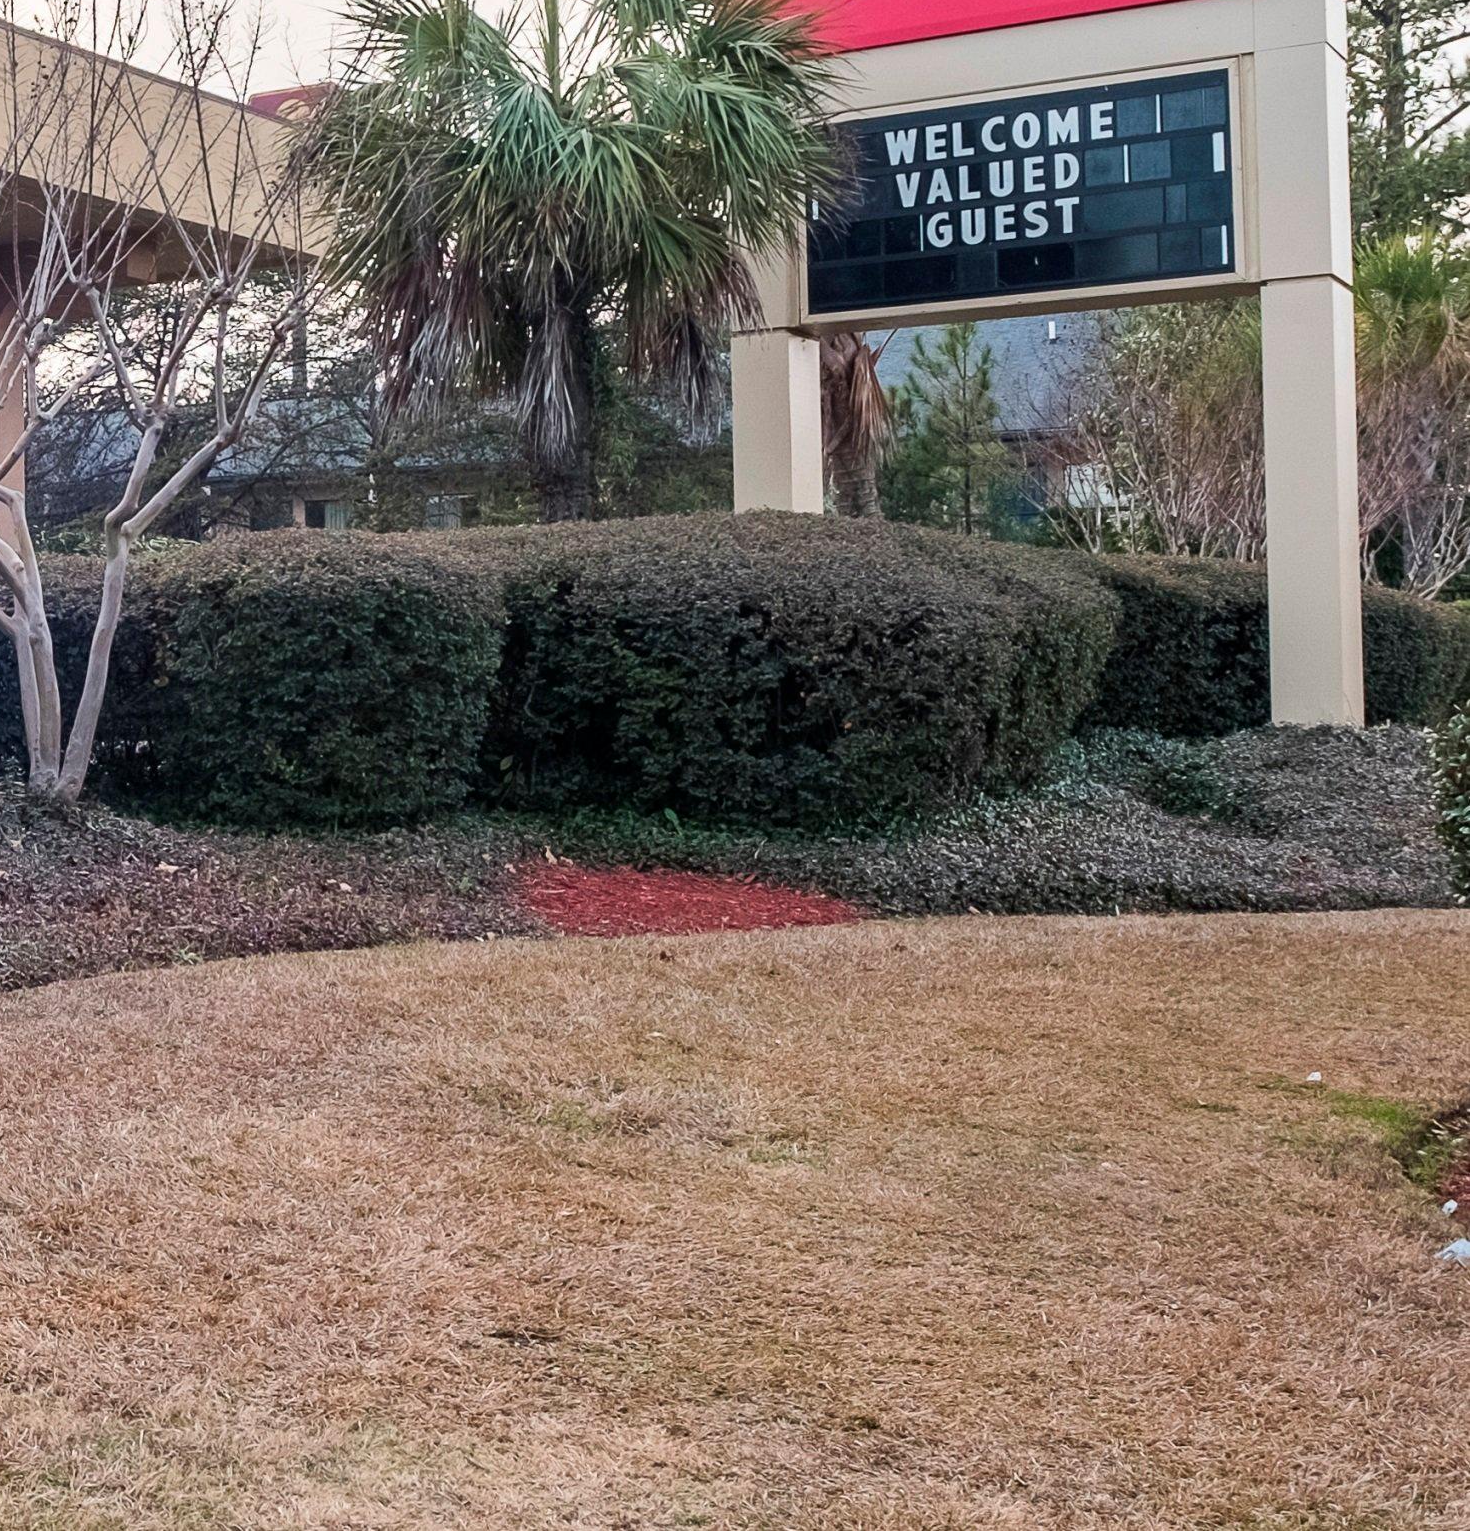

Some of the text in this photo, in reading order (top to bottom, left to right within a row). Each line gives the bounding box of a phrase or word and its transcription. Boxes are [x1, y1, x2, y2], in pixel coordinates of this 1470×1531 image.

[884, 101, 1115, 166] WELCOME
[895, 152, 1081, 208] VALUED
[926, 196, 1081, 249] GUEST
